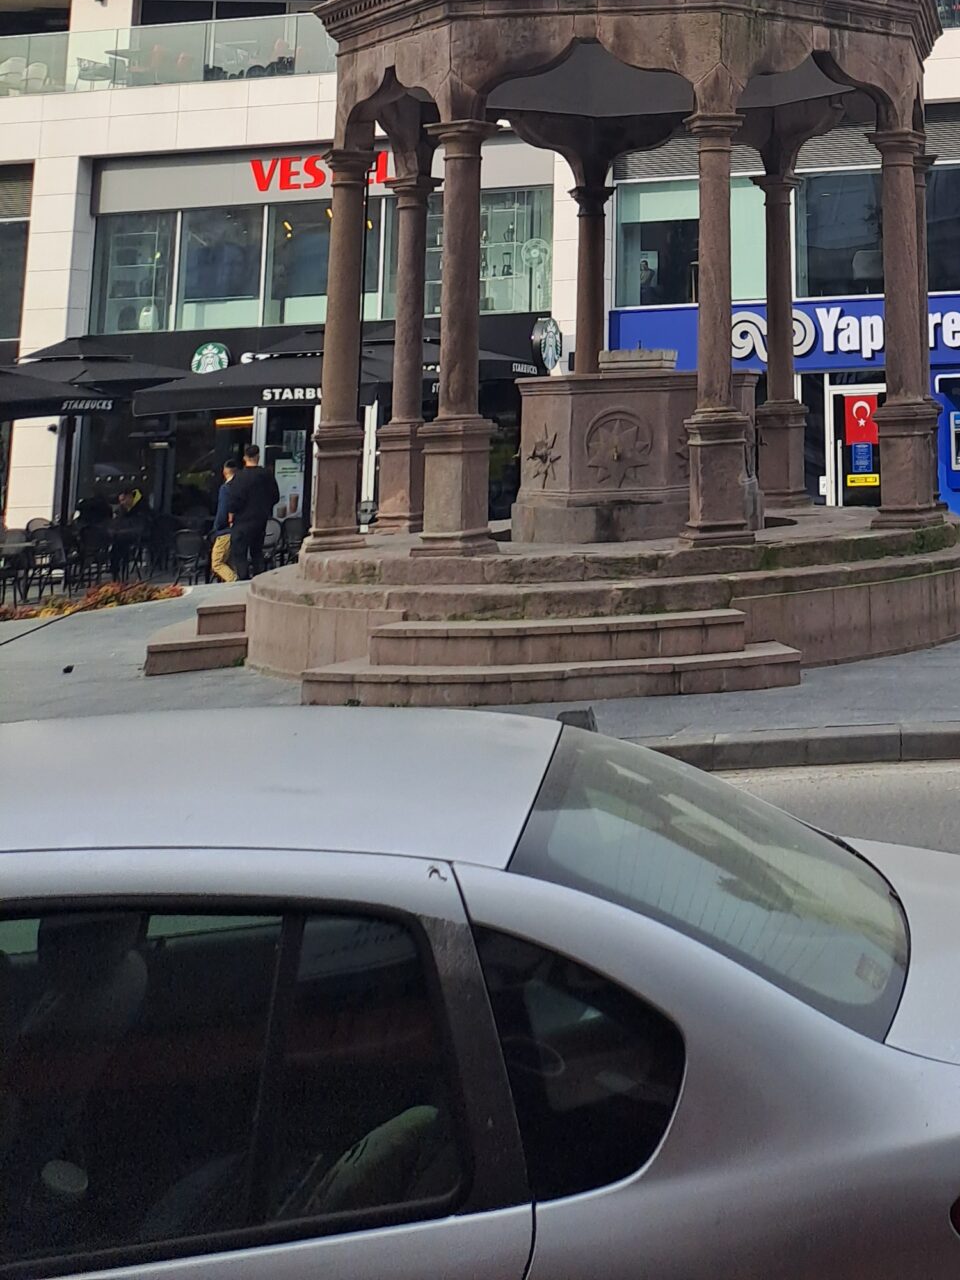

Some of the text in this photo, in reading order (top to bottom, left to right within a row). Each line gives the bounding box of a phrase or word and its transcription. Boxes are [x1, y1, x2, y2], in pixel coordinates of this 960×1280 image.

[250, 150, 400, 192] VESL
[512, 363, 538, 375] STARBUCKS
[262, 387, 323, 401] STARB
[61, 399, 114, 410] STARBUCKS
